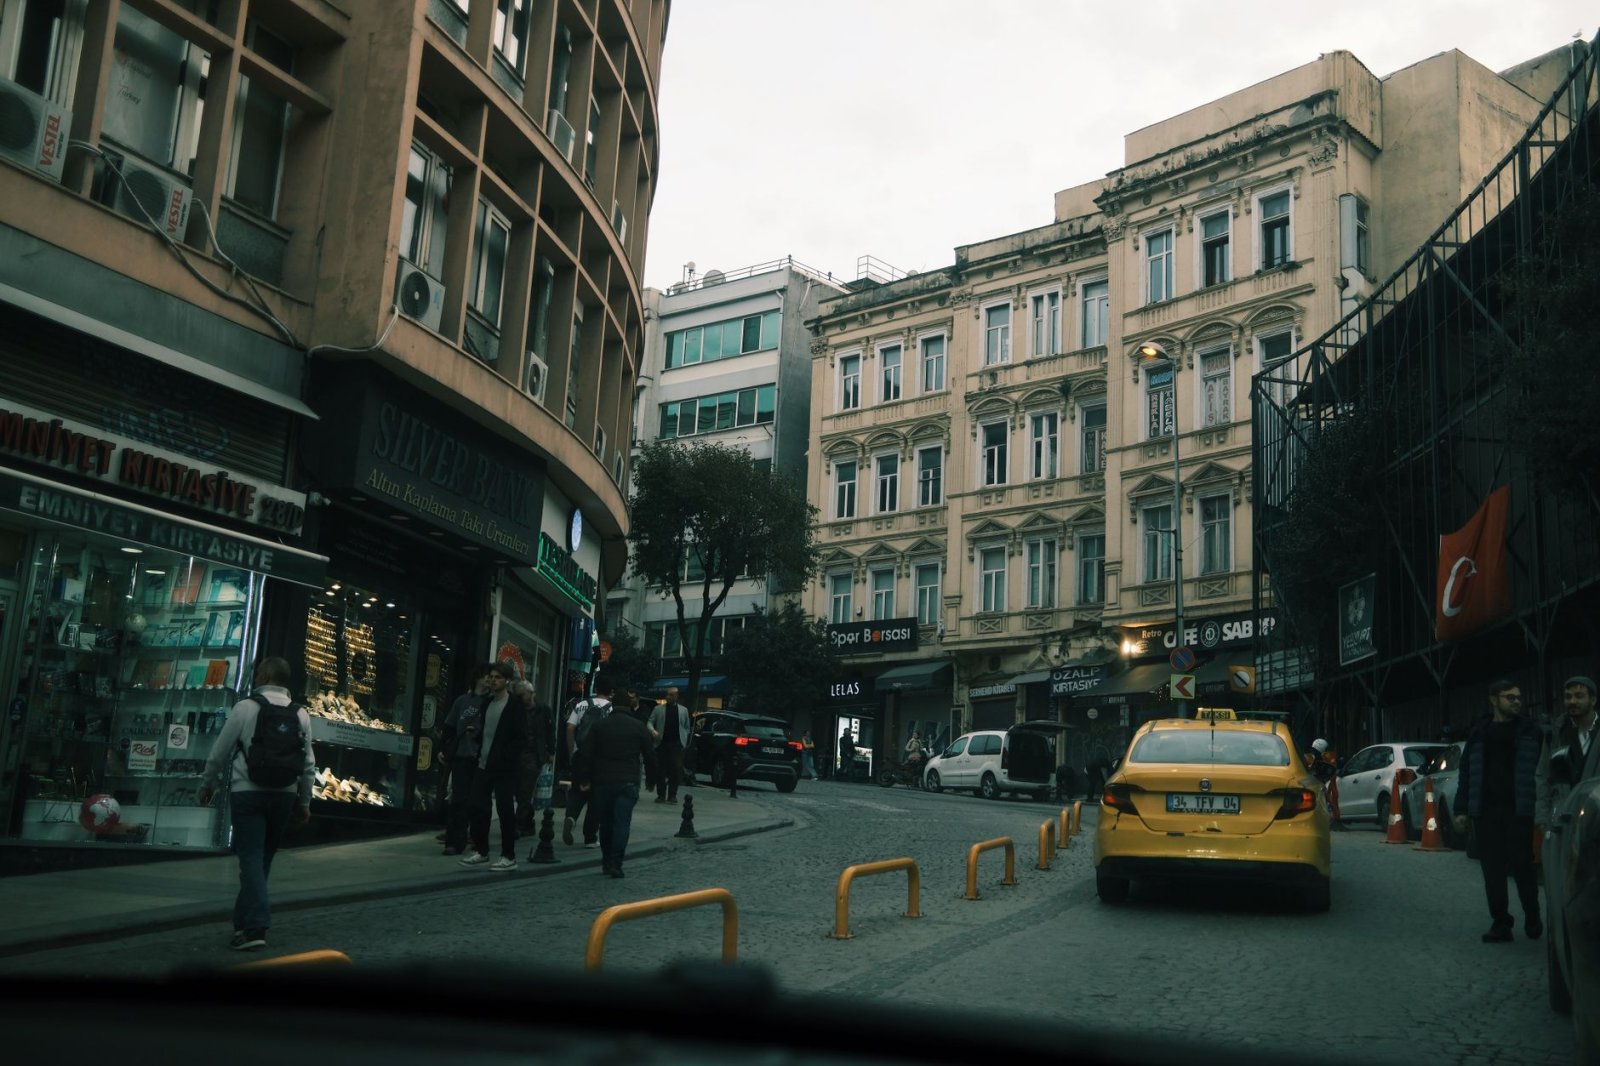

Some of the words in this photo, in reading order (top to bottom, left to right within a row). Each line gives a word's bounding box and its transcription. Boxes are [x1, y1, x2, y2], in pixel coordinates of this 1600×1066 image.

[39, 114, 61, 167] VESTEL
[166, 189, 184, 233] VESTEL
[373, 401, 470, 494] SILVER
[119, 447, 257, 517] KIRTASİYE
[365, 468, 400, 498] Altın
[402, 484, 458, 524] Kaplama
[459, 510, 483, 536] Takı
[18, 485, 144, 537] EMNİYET
[1141, 629, 1162, 639] Retro
[831, 682, 860, 697] LELAS
[1174, 796, 1187, 808] 34
[1195, 796, 1215, 809] TFV
[1223, 797, 1237, 809] 04
